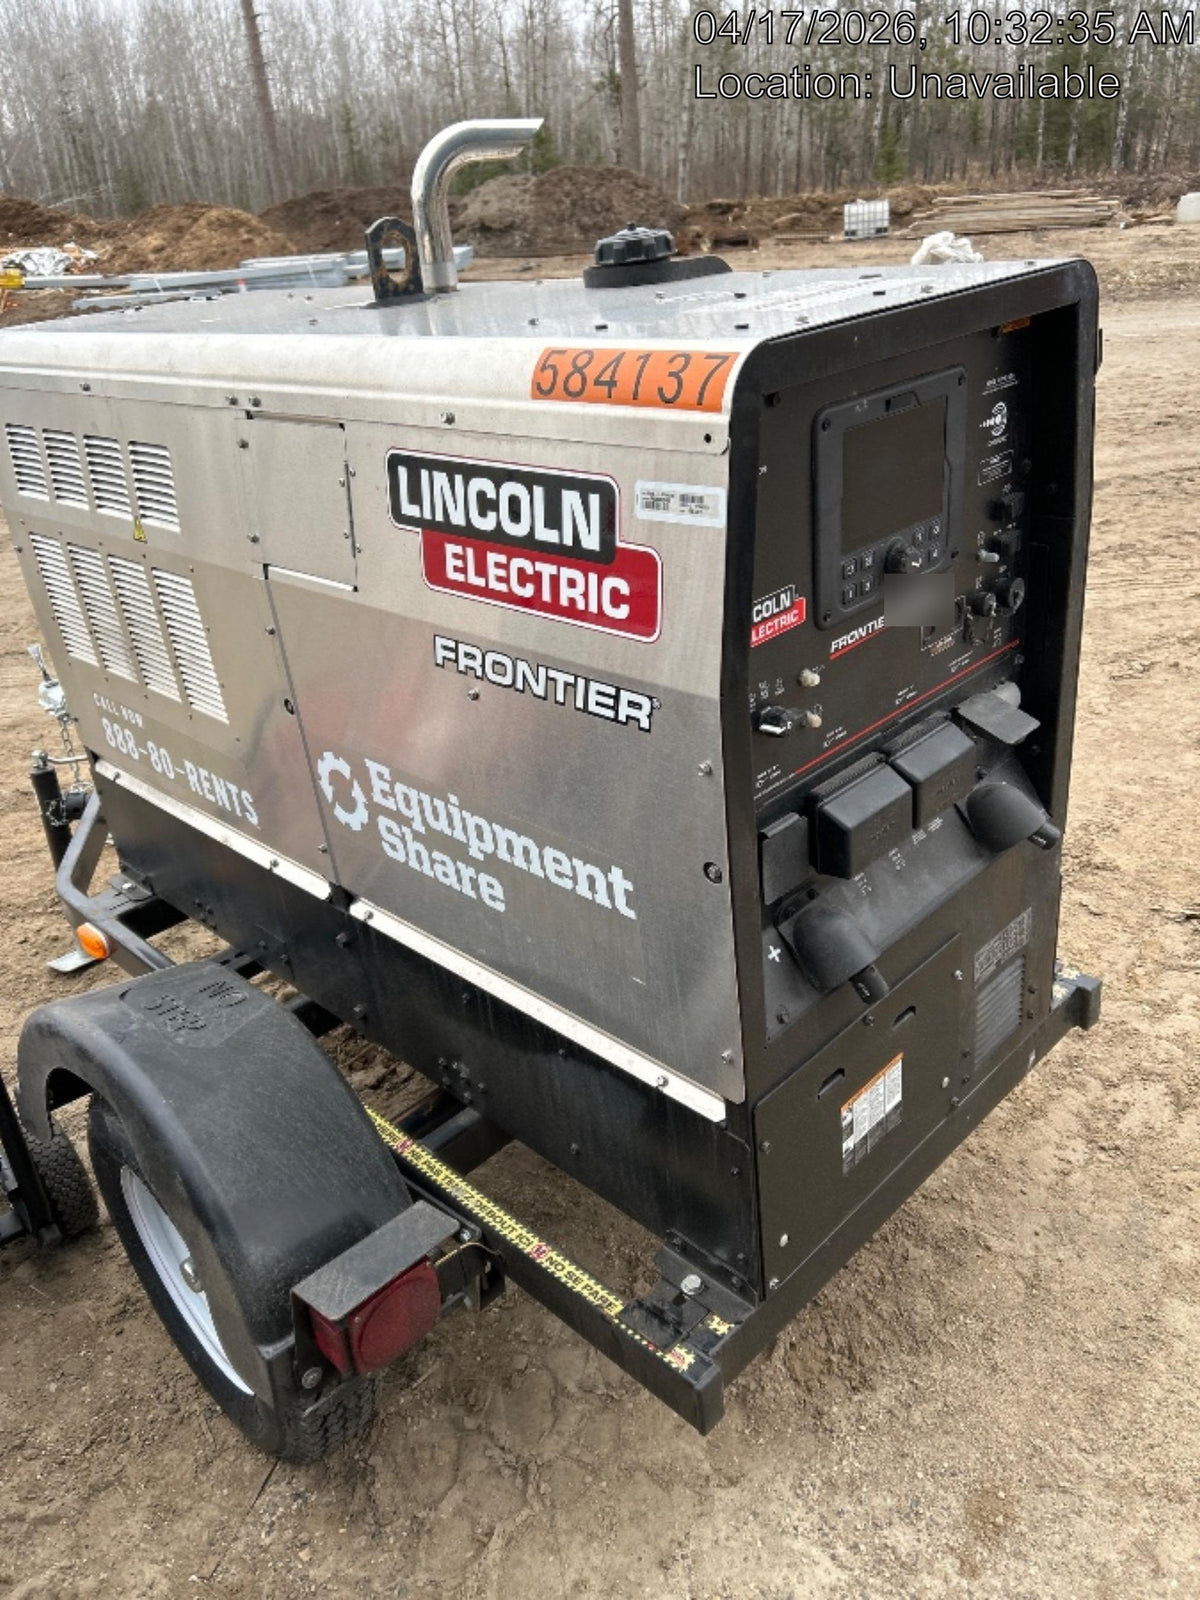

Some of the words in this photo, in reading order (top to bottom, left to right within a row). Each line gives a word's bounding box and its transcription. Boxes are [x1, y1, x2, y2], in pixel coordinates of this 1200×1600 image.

[536, 349, 730, 406] 584137
[397, 464, 601, 552] LINCOLN
[444, 541, 631, 620] ELECTRIC
[753, 590, 791, 623] COLN
[751, 609, 799, 642] LECTRIC
[830, 615, 885, 654] FRONTIE
[101, 717, 259, 826] 888-80-RENTS
[364, 758, 637, 920] Equipment
[376, 815, 506, 912] Share
